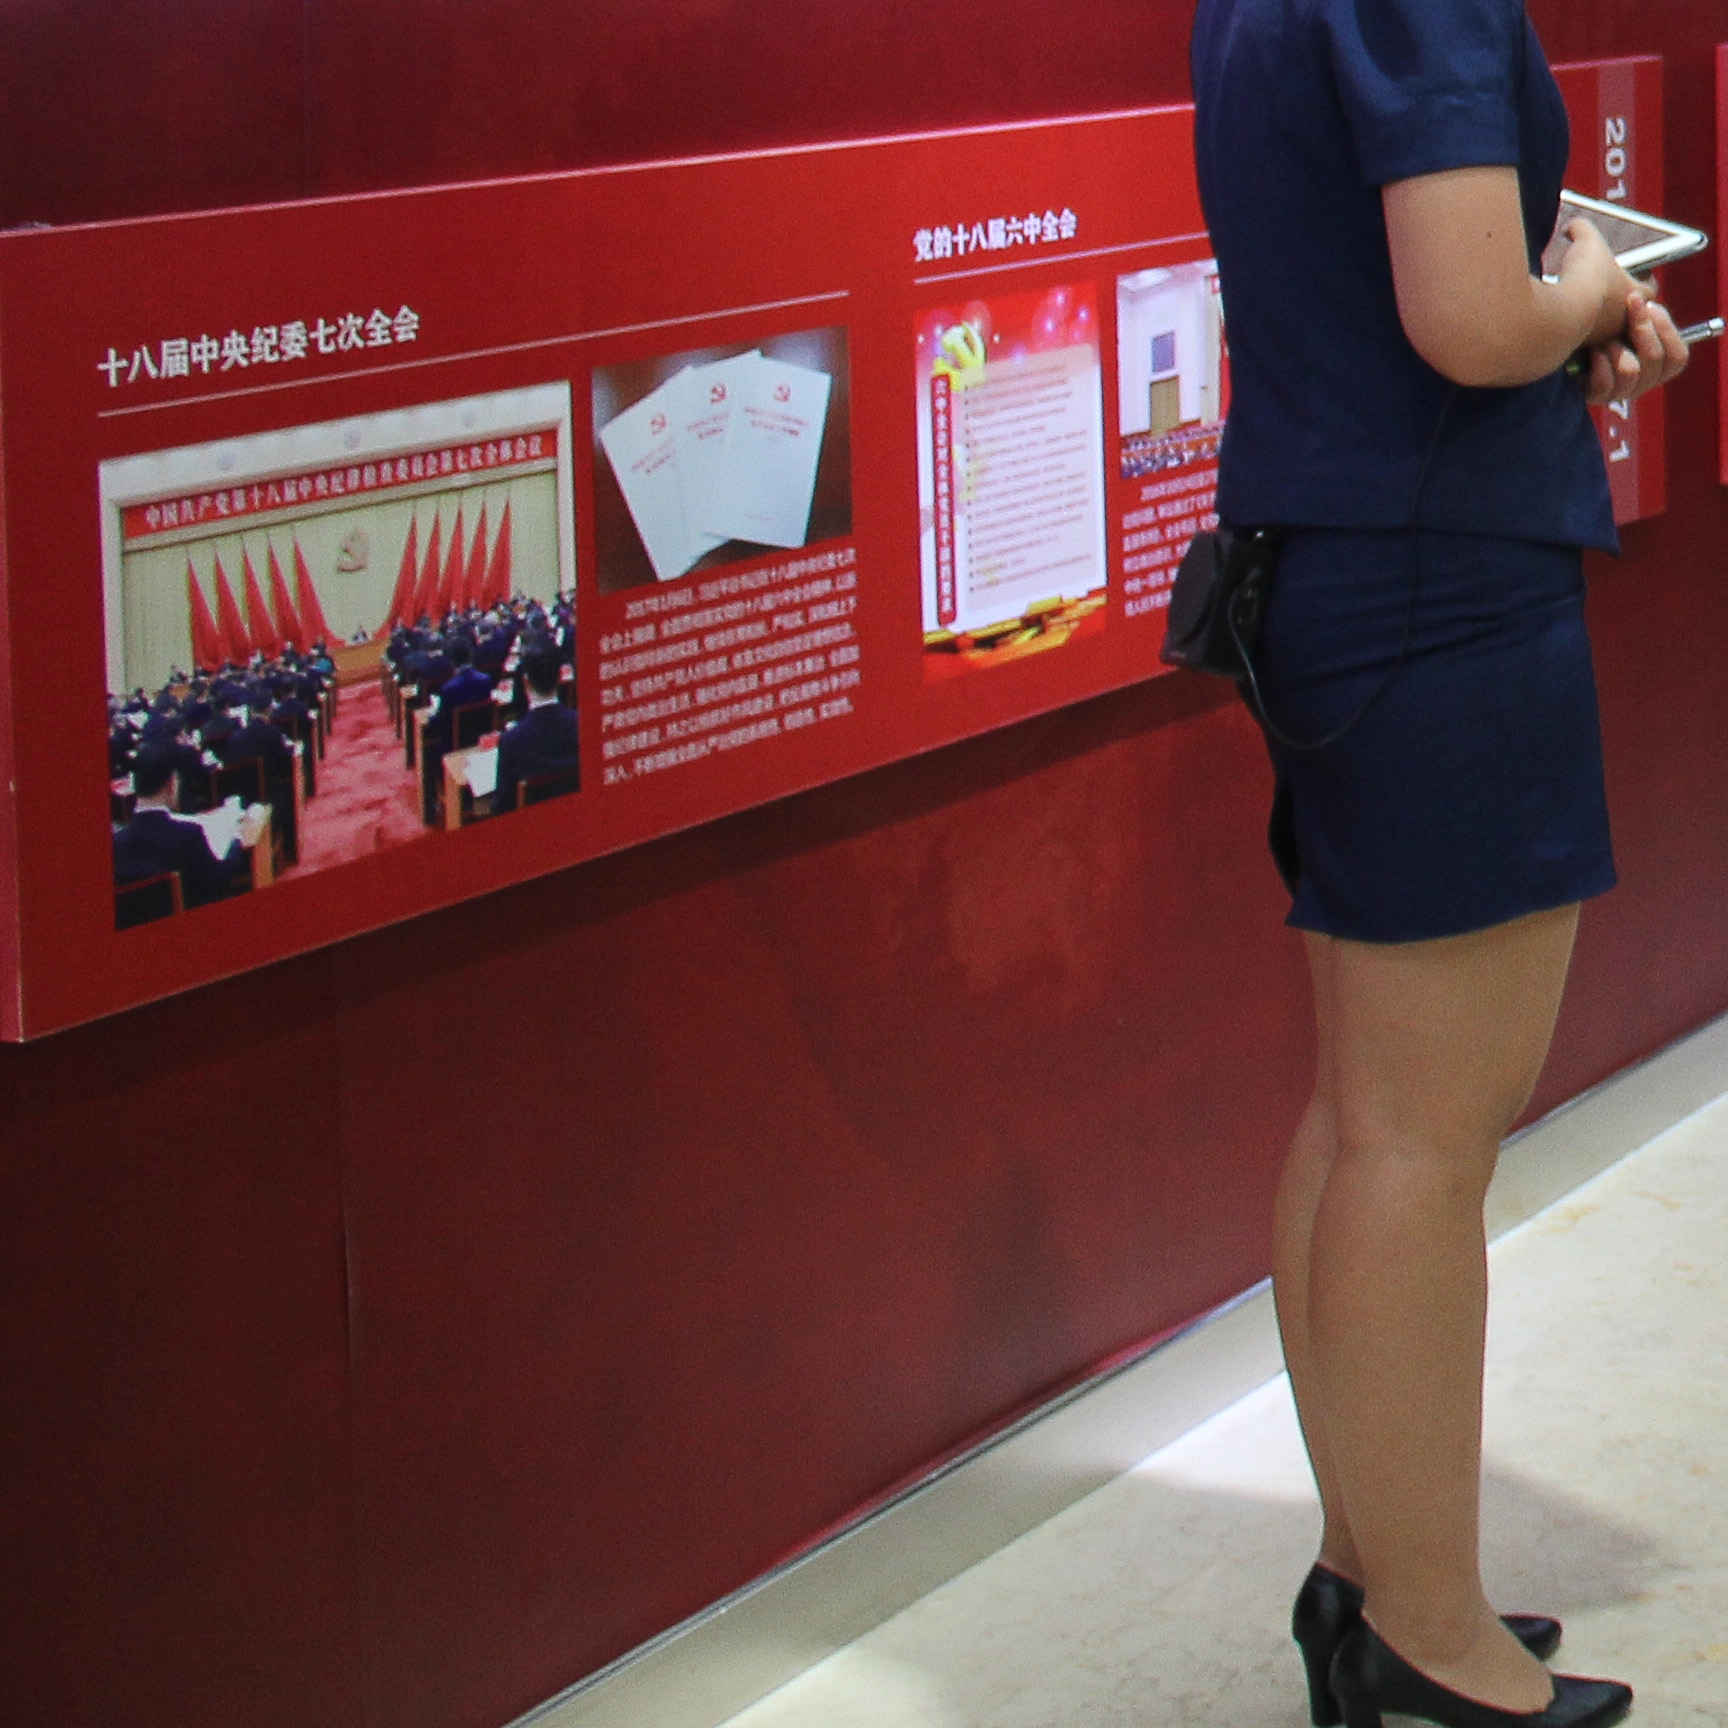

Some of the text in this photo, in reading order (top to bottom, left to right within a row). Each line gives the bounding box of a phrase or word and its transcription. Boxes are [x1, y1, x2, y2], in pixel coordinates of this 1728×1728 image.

[912, 206, 1078, 263] 党的十八届六中全会
[97, 304, 421, 388] 十八届中央纪委七次全会
